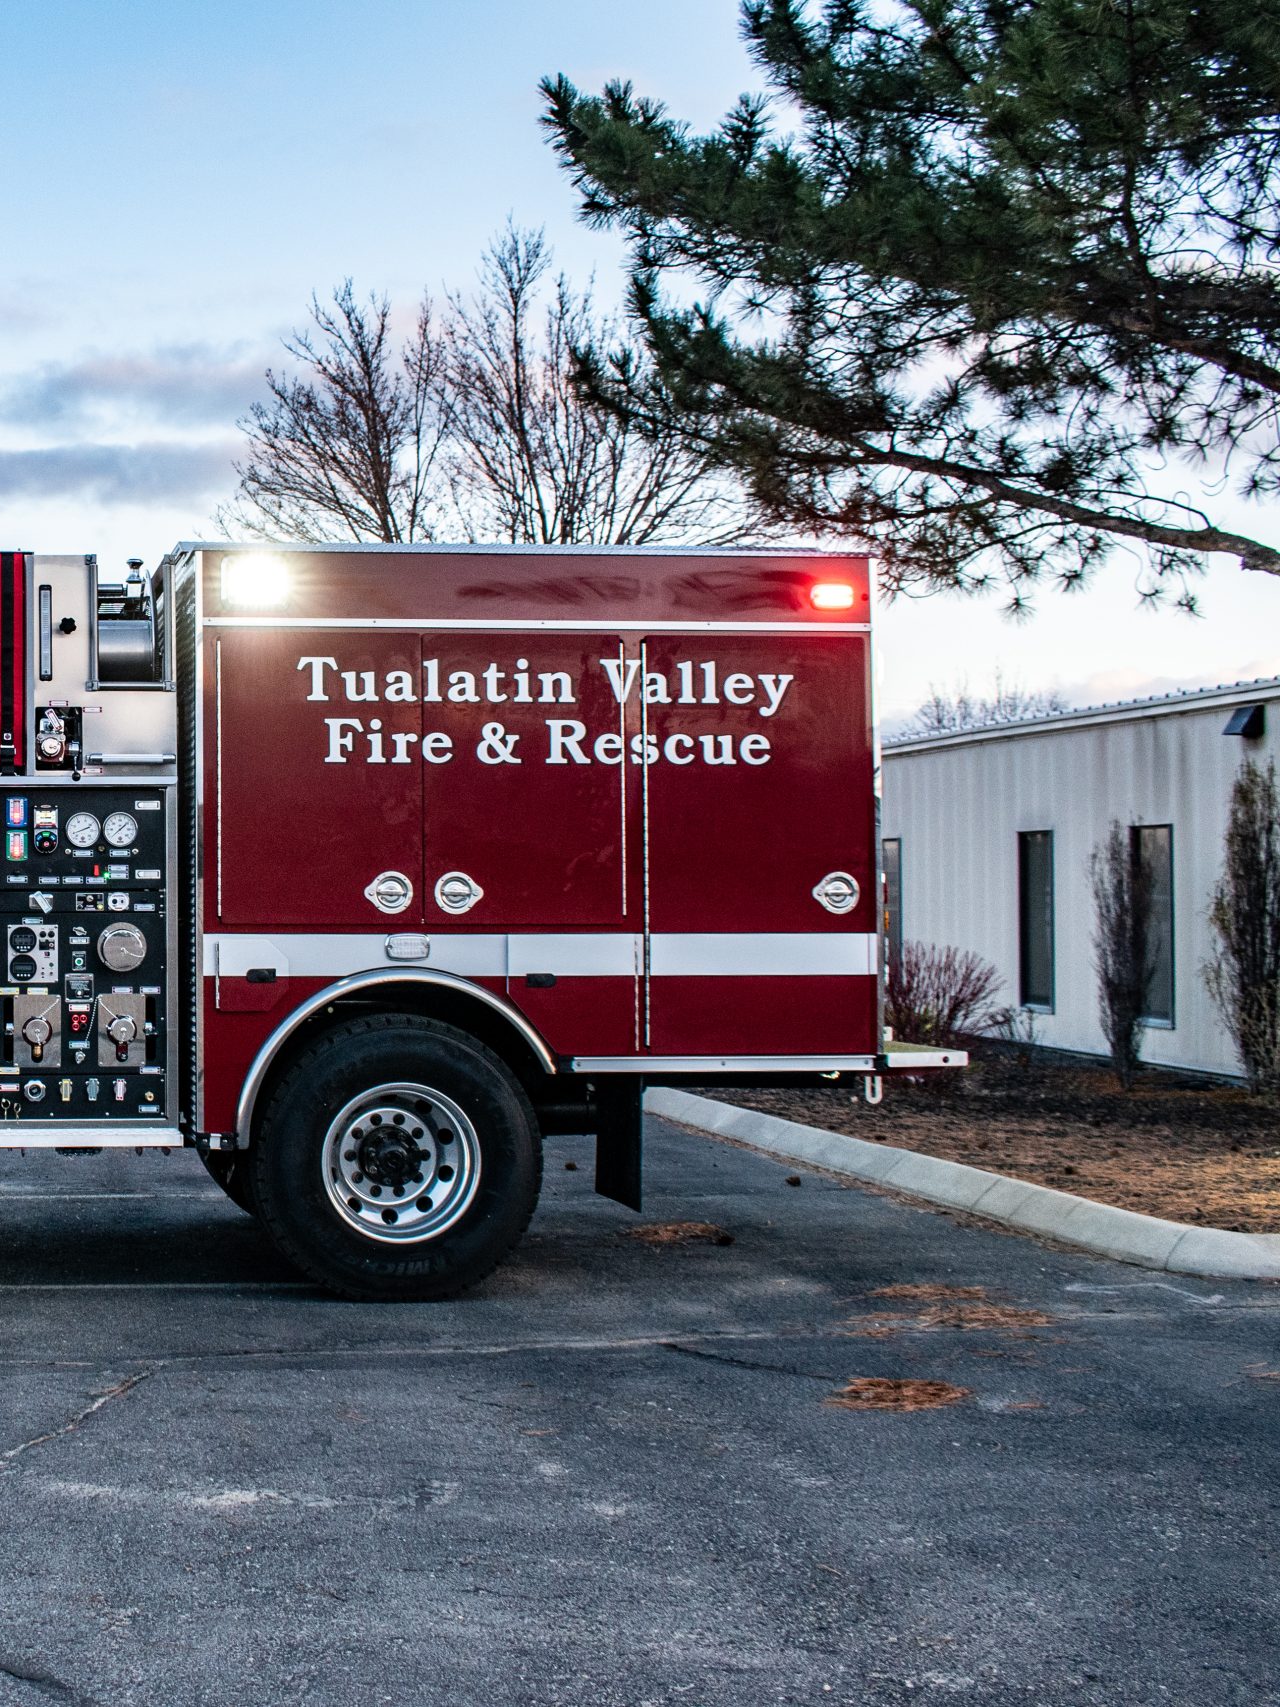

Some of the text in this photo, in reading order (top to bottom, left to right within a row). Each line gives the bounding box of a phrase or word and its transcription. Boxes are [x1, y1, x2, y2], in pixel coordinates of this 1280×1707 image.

[296, 656, 795, 717] Tualatin Valley
[323, 717, 772, 766] Fire & Rescue
